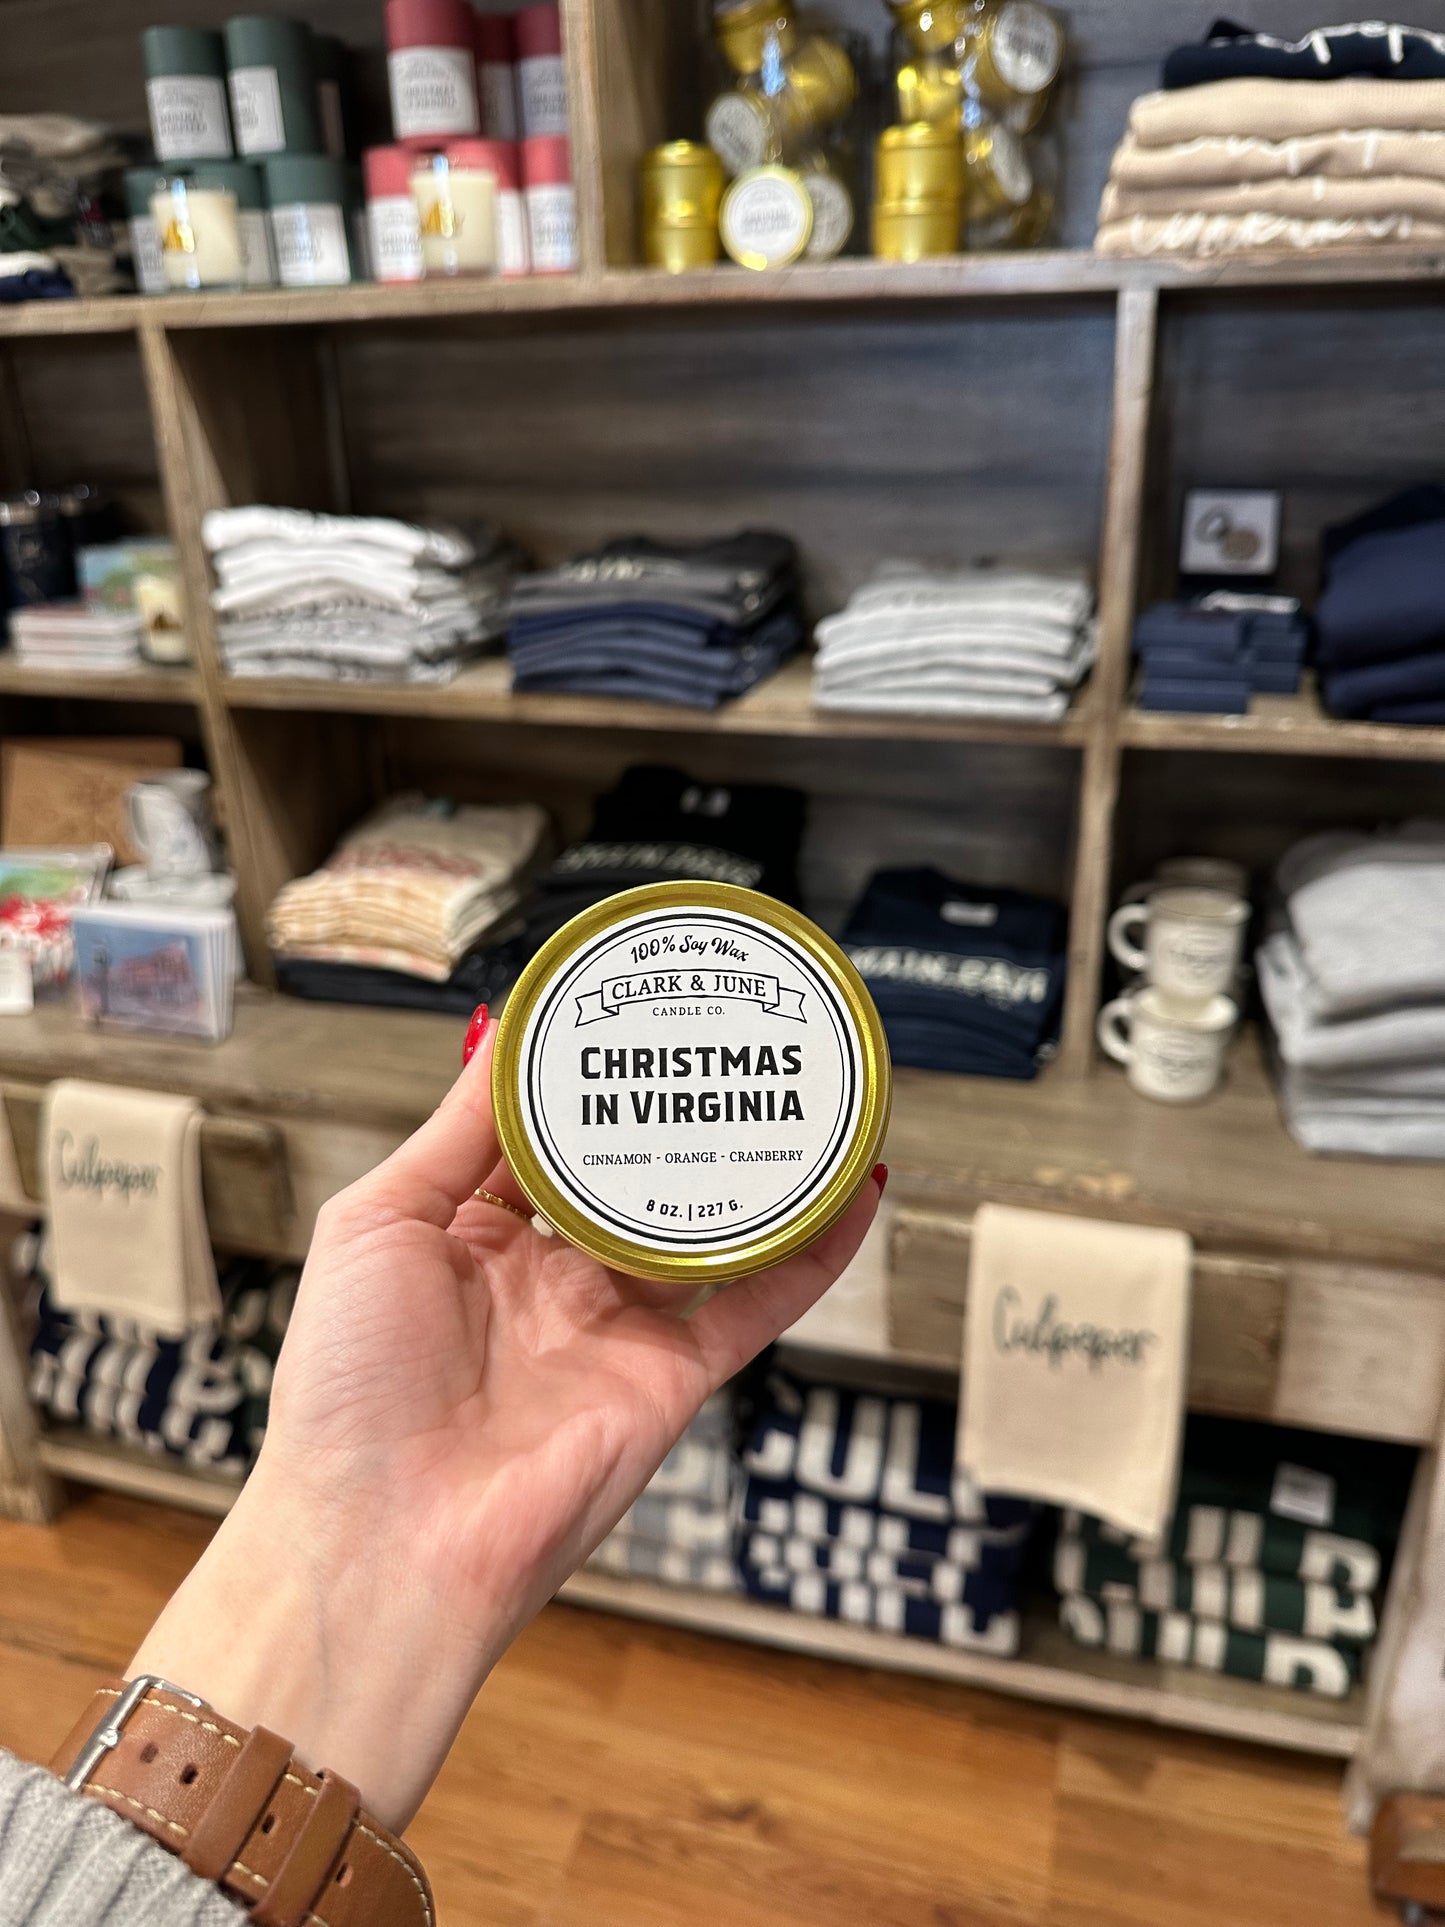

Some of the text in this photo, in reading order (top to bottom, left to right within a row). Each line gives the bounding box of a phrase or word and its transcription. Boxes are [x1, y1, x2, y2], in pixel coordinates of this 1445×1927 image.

[630, 934, 750, 964] 100% Soy Wax
[611, 974, 766, 999] CLARK & JUNE
[652, 1006, 726, 1017] CANDLE CO.
[580, 1045, 802, 1080] CHRISTMAS
[581, 1089, 805, 1126] IN VIRGINIA
[582, 1153, 652, 1166] CINNAMON
[664, 1151, 717, 1164] ORANGE
[729, 1149, 804, 1163] CRANBERRY
[646, 1199, 656, 1212] 8
[659, 1203, 683, 1218] OZ.
[697, 1201, 723, 1218] 227
[728, 1199, 744, 1212] G.
